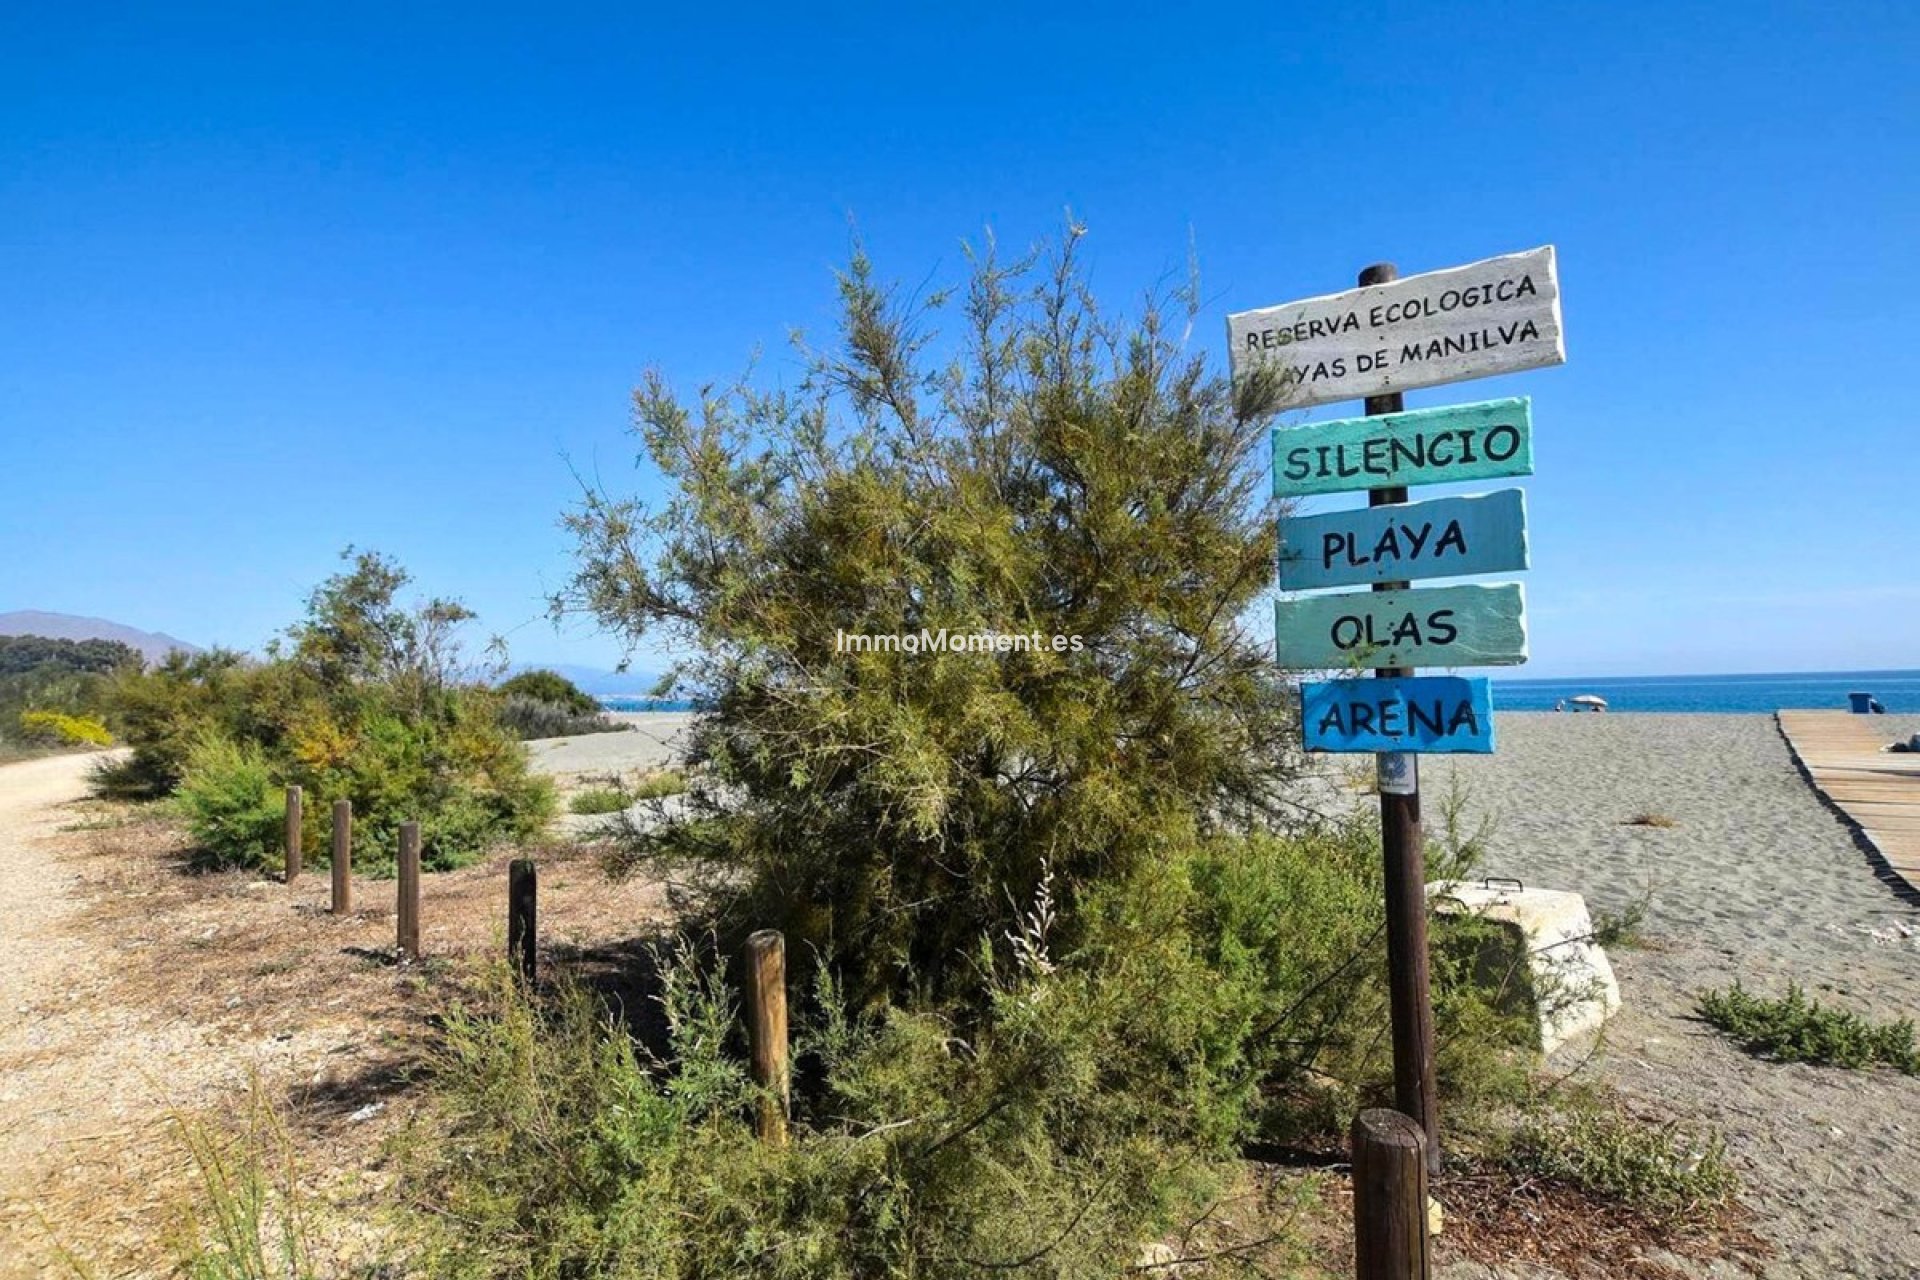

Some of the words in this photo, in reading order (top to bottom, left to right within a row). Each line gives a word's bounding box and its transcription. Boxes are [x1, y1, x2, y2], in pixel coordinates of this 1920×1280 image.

[1246, 311, 1360, 351] RESERVA
[1369, 274, 1537, 328] ECOLOGICA
[1357, 349, 1389, 373] DE
[1399, 319, 1539, 365] MANILVA
[1283, 425, 1521, 480] SILENCIO
[1322, 519, 1467, 569] PLAYA
[1330, 610, 1458, 650] OLAS
[1318, 699, 1479, 737] ARENA
